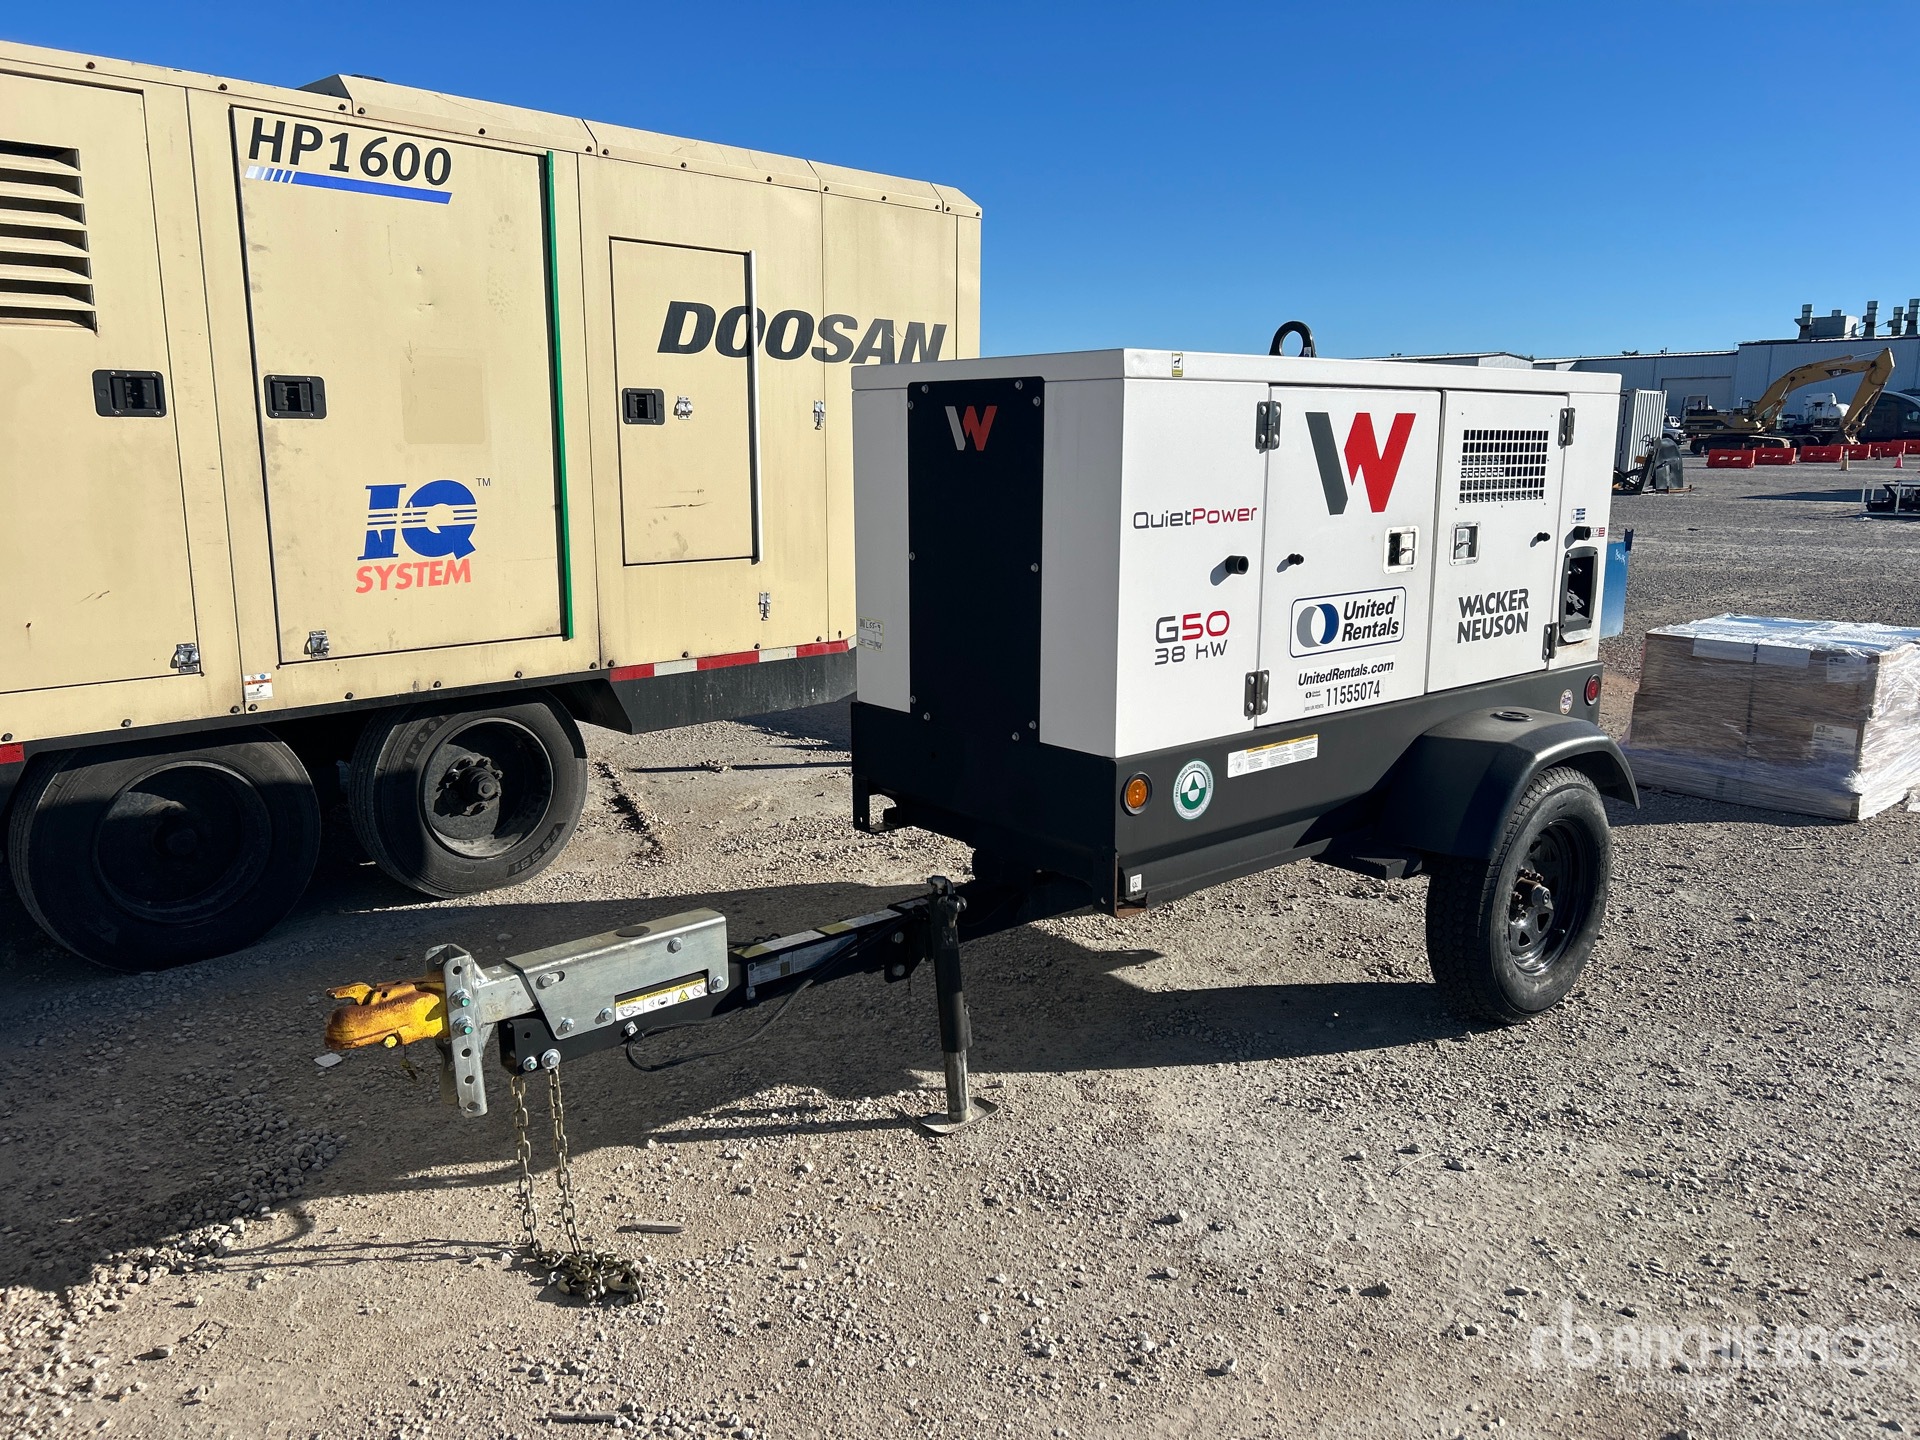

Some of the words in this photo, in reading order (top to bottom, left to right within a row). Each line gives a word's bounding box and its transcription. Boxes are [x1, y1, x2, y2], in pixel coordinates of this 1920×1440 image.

[249, 117, 452, 186] HP1600
[657, 301, 947, 365] DOOSAN
[357, 480, 477, 560] IQ
[1133, 507, 1257, 529] QuietPower
[356, 559, 471, 594] SYSTEM
[1344, 596, 1397, 620] United
[1458, 588, 1529, 618] WACKER
[1156, 610, 1230, 643] G50
[1342, 617, 1399, 642] Rentals
[1457, 612, 1529, 643] NEUSON
[1155, 645, 1185, 665] 38
[1298, 661, 1394, 686] UnitedRentals.com
[1326, 680, 1380, 706] 11555074
